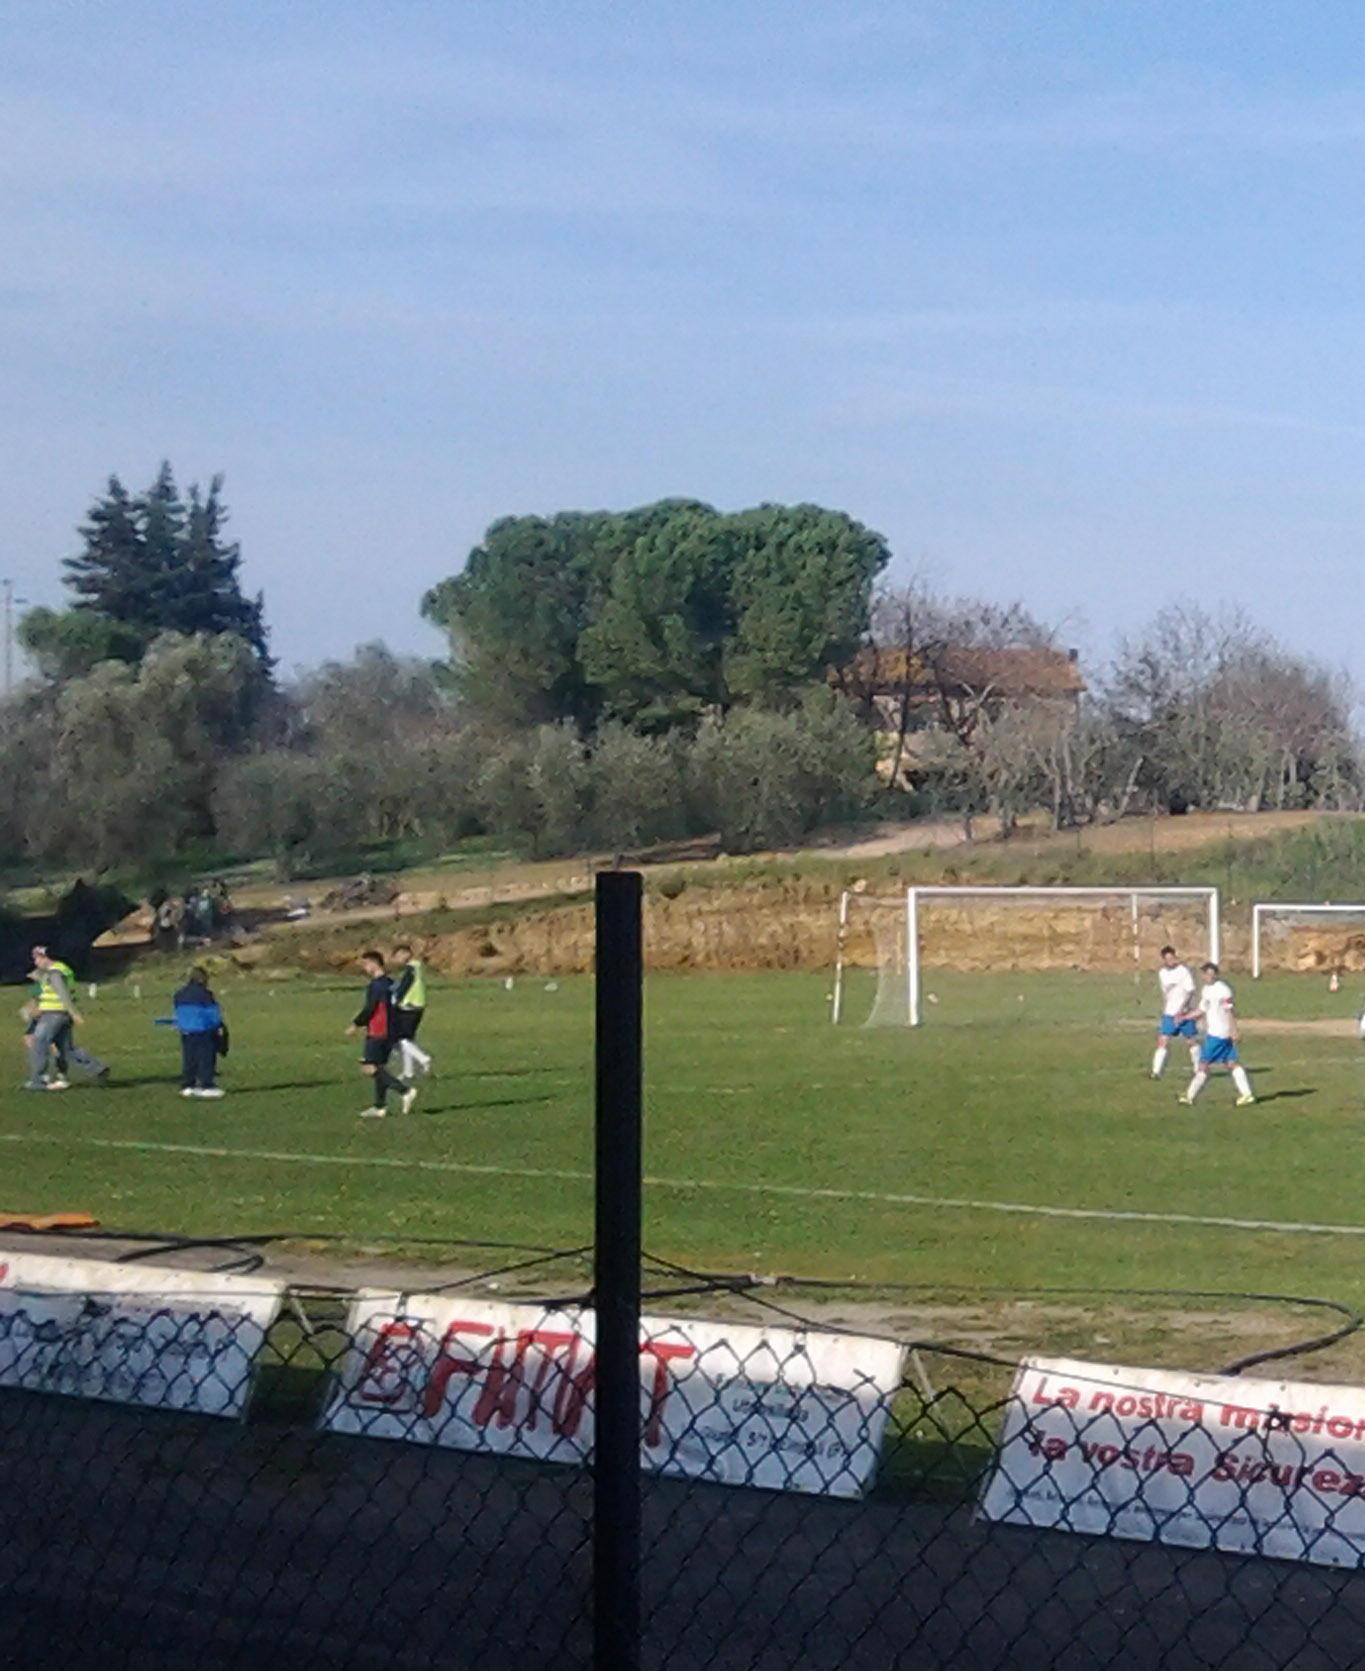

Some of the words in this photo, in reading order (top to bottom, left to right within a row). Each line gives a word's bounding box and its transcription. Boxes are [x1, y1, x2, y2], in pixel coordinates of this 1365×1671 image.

[1033, 1377, 1080, 1409] La
[1088, 1391, 1204, 1421] nostra
[1081, 1441, 1195, 1476] vostra
